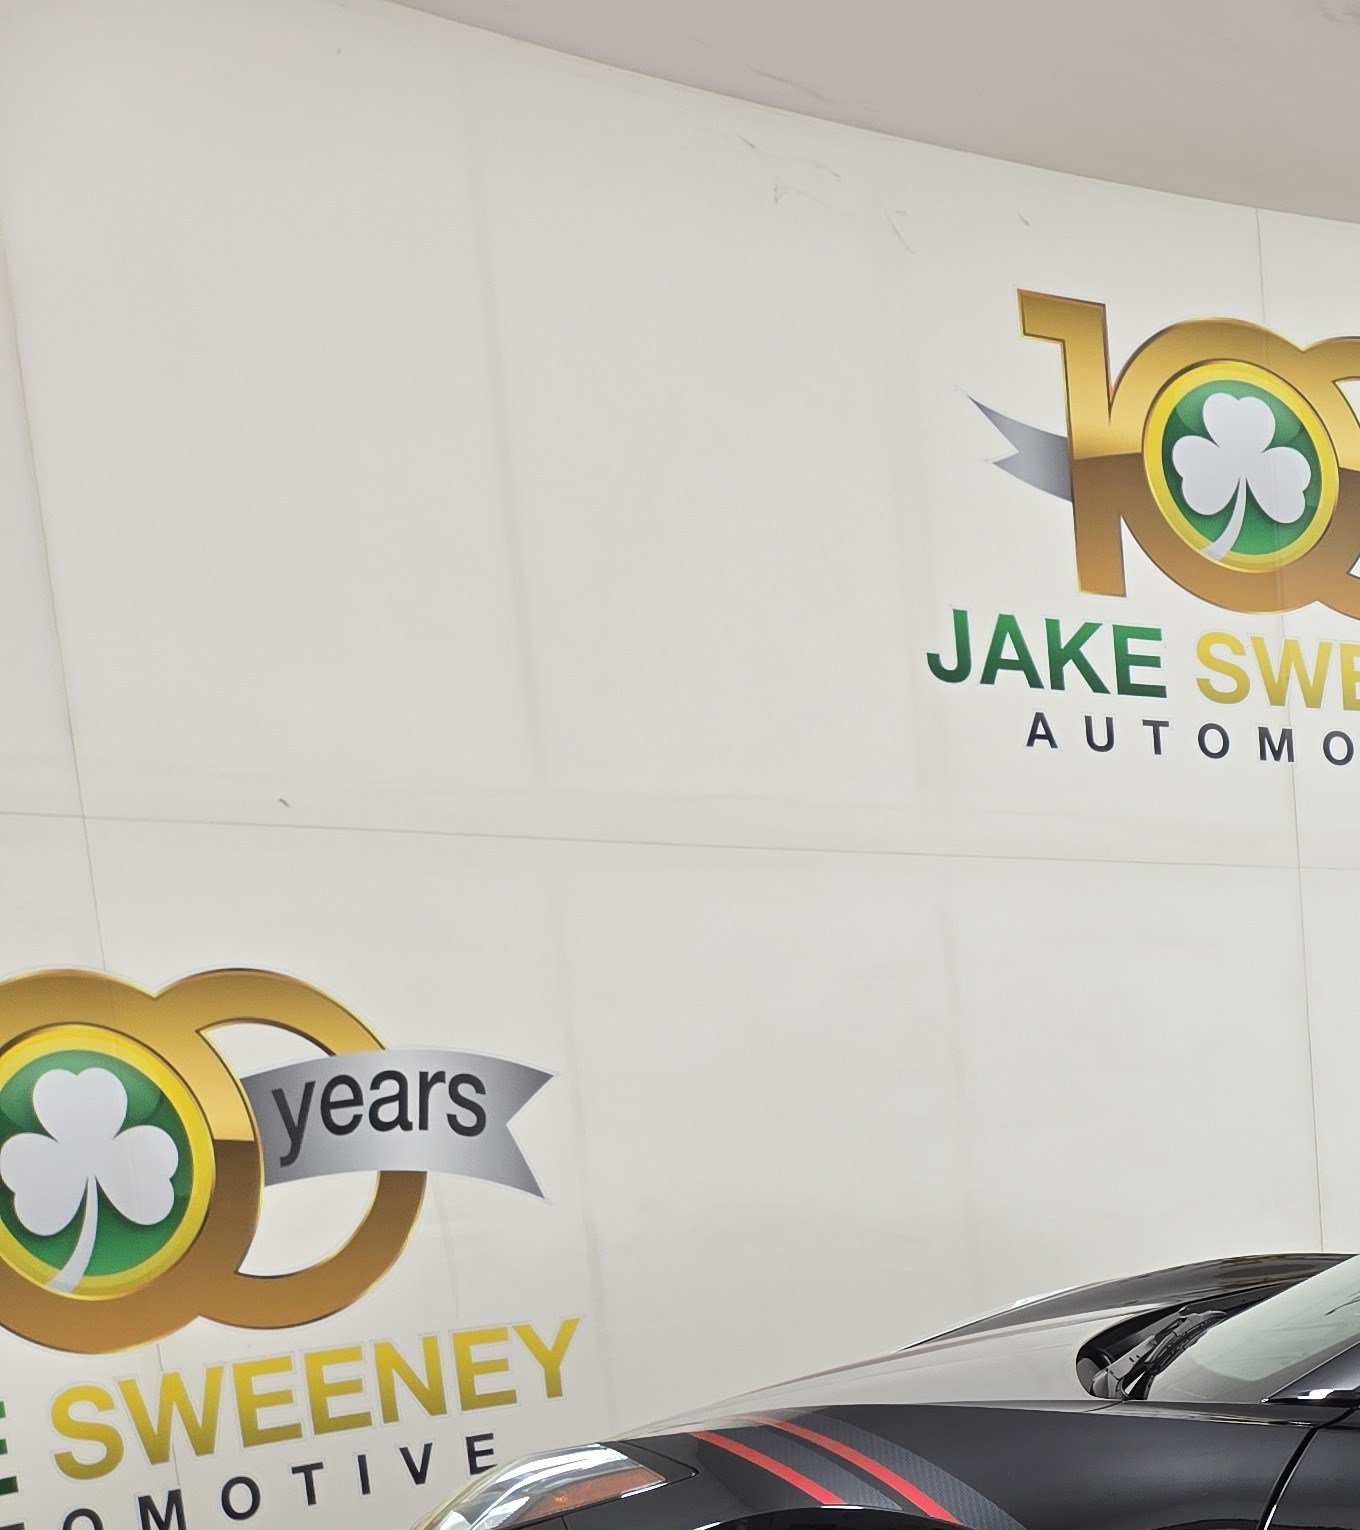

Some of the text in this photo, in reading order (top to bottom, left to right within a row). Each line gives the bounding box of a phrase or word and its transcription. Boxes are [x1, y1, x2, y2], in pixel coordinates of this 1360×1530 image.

[925, 609, 1169, 700] JAKE
[271, 1068, 488, 1168] years
[50, 1317, 581, 1481] SWEENEY
